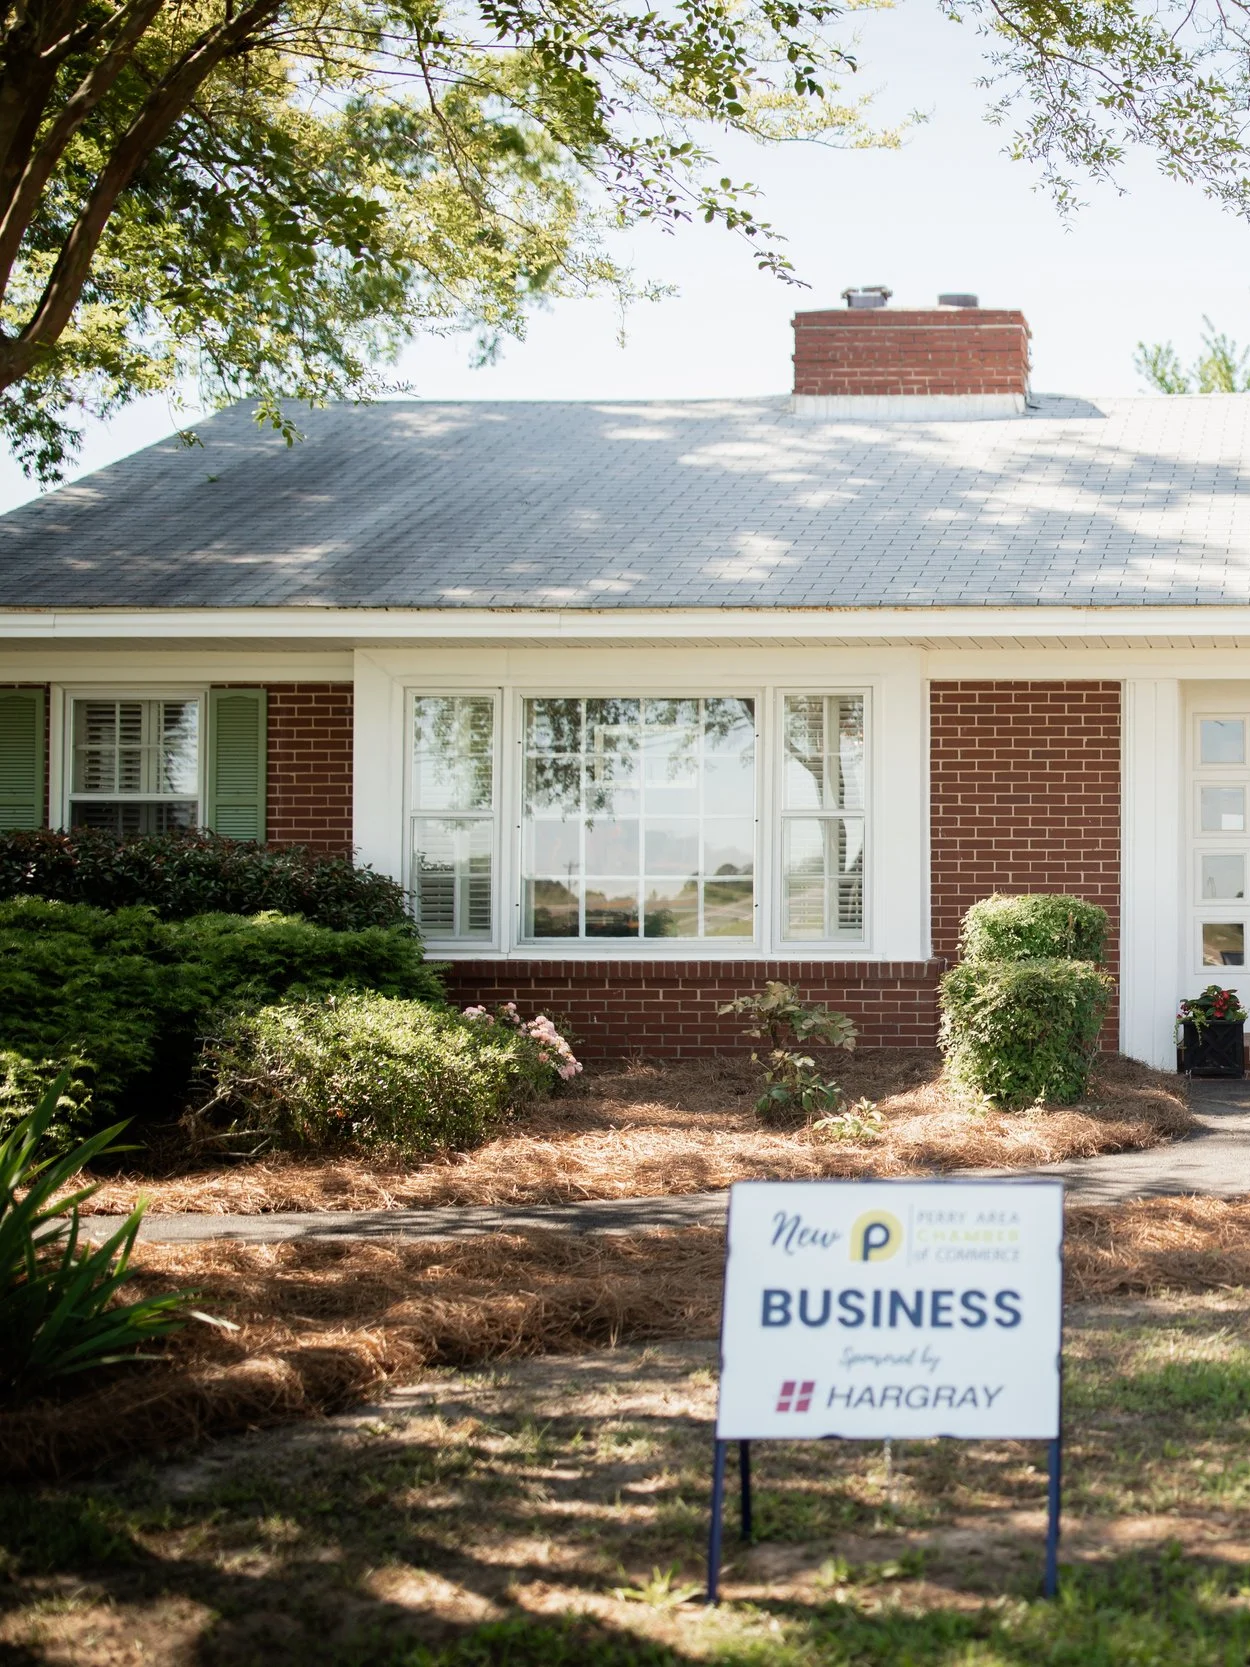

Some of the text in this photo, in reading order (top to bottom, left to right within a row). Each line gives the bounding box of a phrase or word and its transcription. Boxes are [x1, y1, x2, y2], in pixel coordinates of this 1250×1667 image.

[916, 1211, 1020, 1225] PERRY AREA
[771, 1210, 840, 1256] New
[916, 1229, 1019, 1243] CHAMBER
[935, 1247, 1020, 1262] COMMERCE
[761, 1289, 1022, 1328] BUSINESS
[921, 1343, 942, 1375] by
[826, 1385, 1004, 1409] HARGRAY
